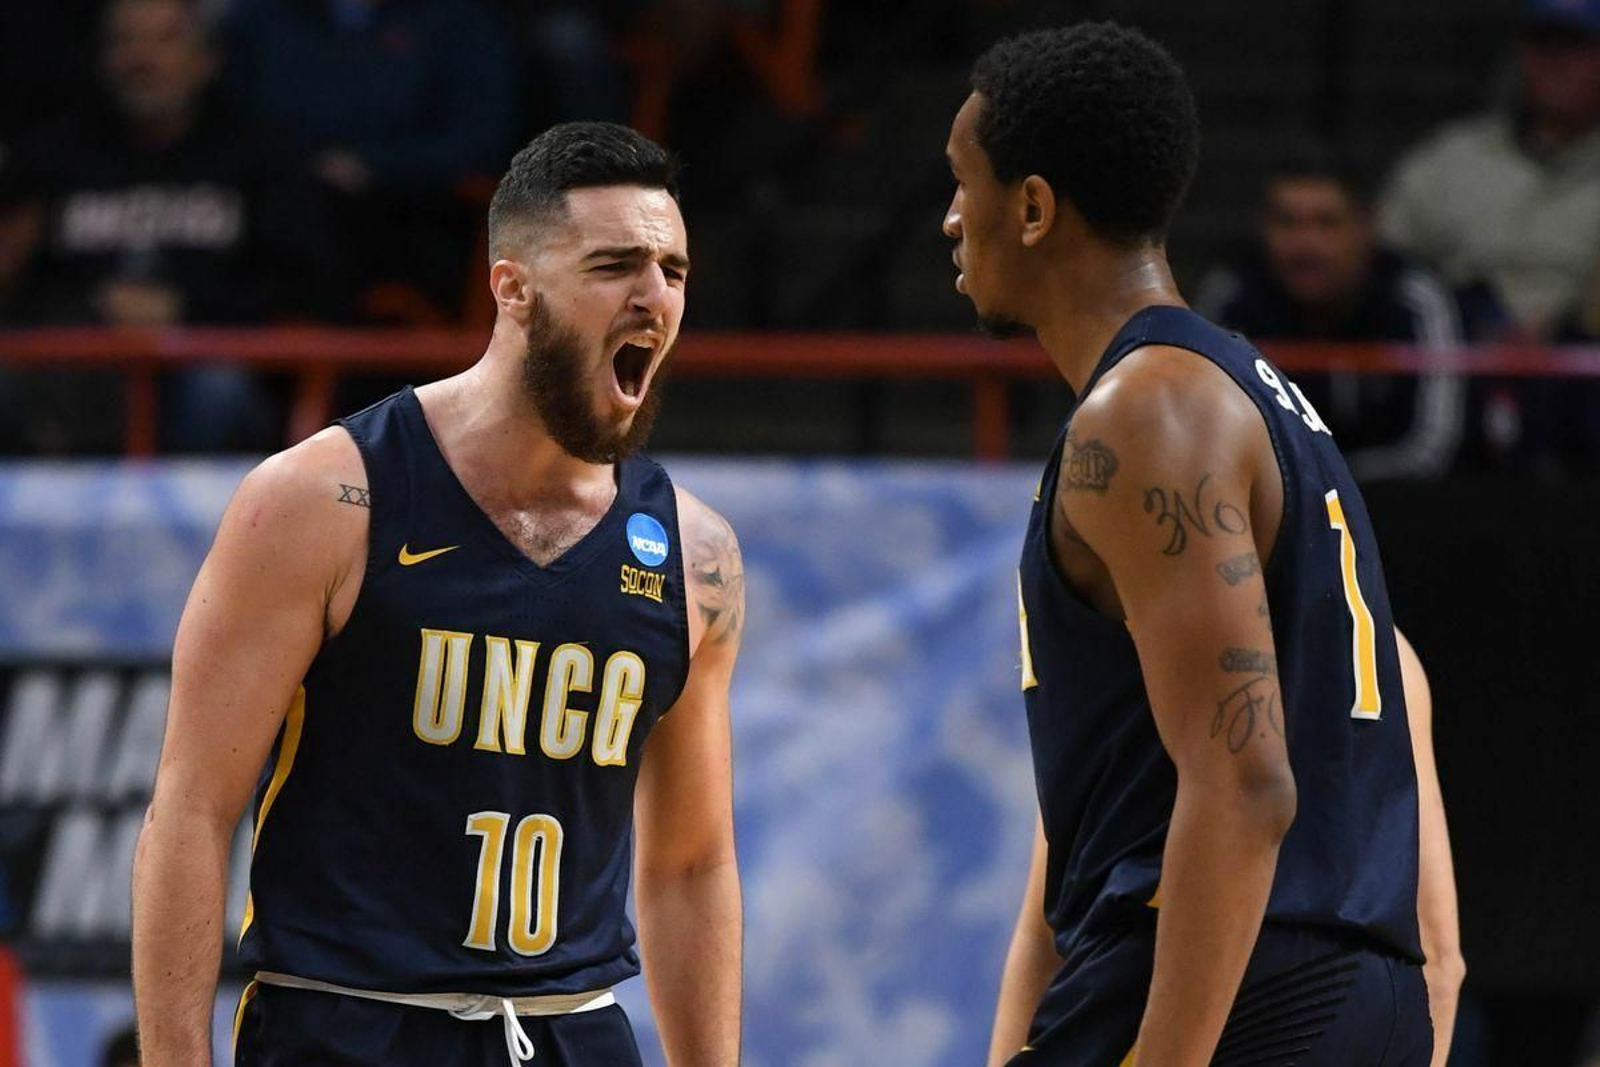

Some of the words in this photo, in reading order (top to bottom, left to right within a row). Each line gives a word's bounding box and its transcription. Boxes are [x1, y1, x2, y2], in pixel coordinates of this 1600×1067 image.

[632, 535, 667, 557] NCAA
[1325, 489, 1381, 721] 1
[412, 629, 646, 766] UNCG
[461, 811, 564, 957] 10
